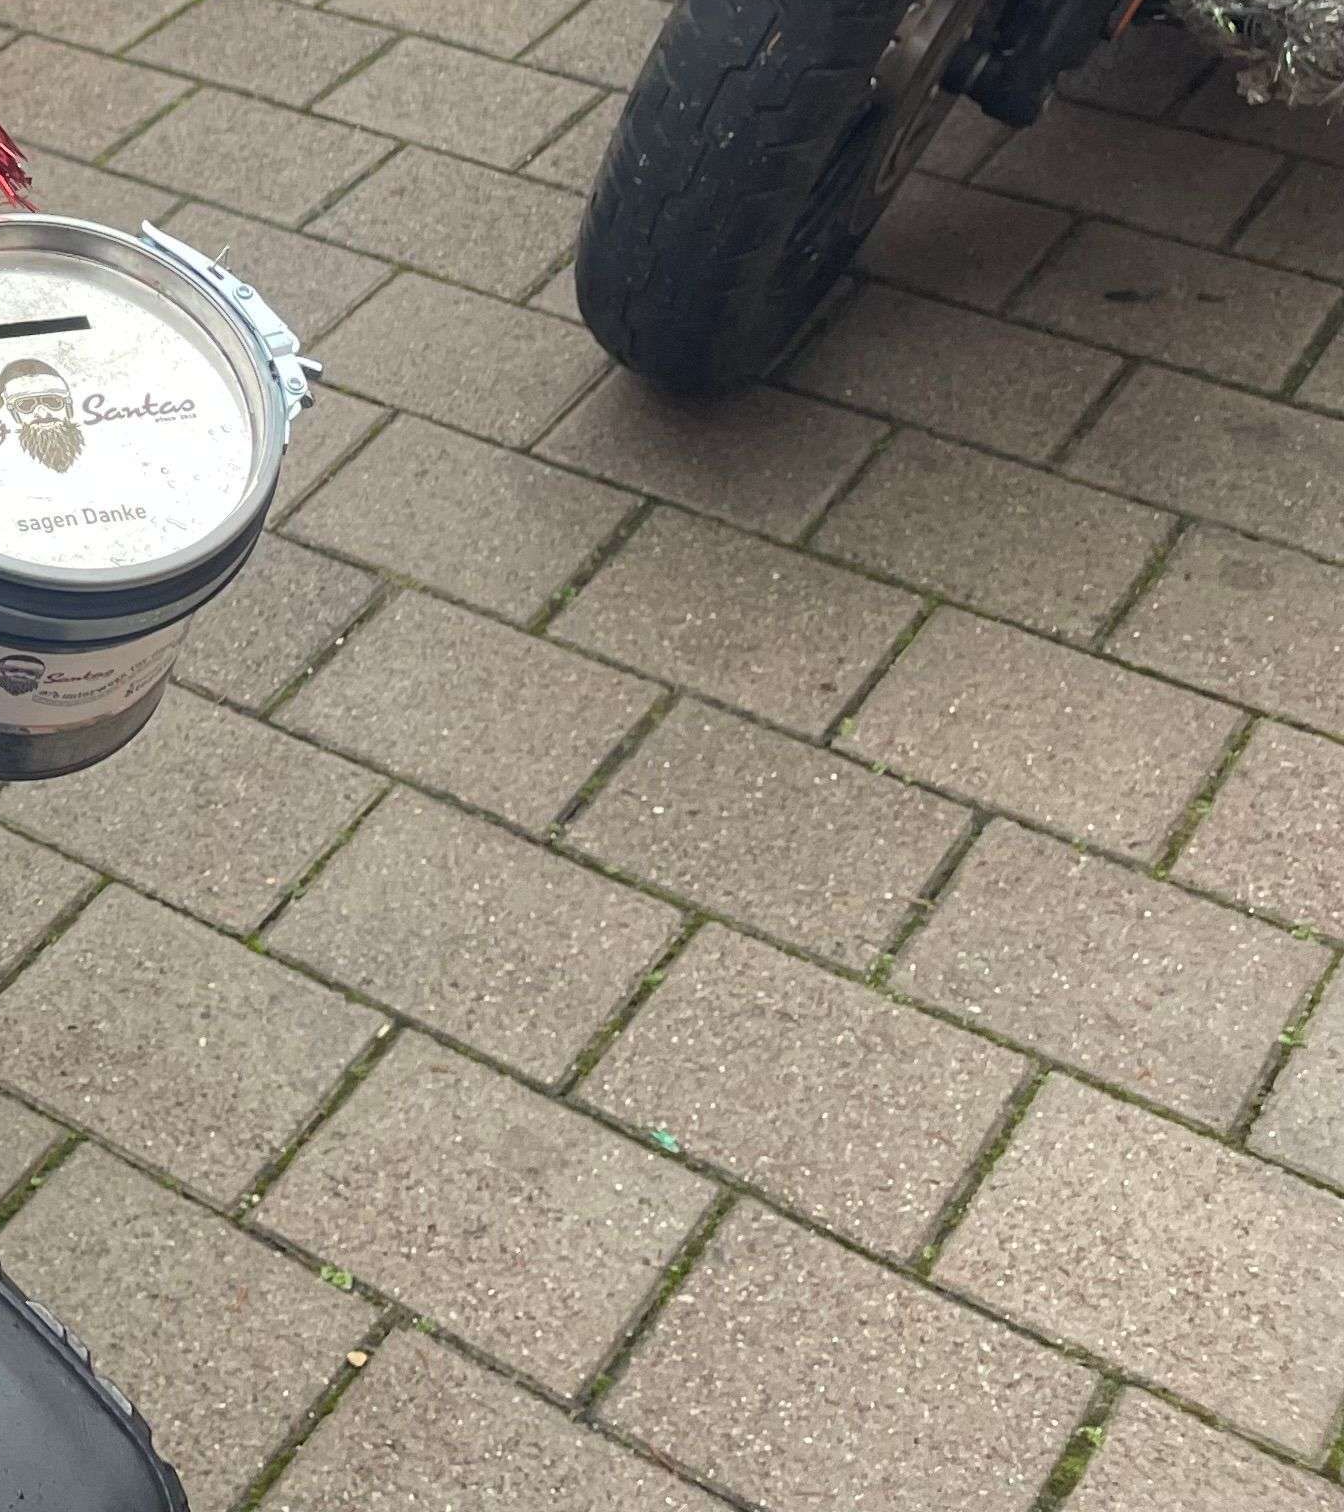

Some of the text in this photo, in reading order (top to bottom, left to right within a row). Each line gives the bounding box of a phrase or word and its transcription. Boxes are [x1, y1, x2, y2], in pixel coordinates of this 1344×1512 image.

[82, 392, 196, 426] Santas
[18, 503, 147, 534] sagen Danke
